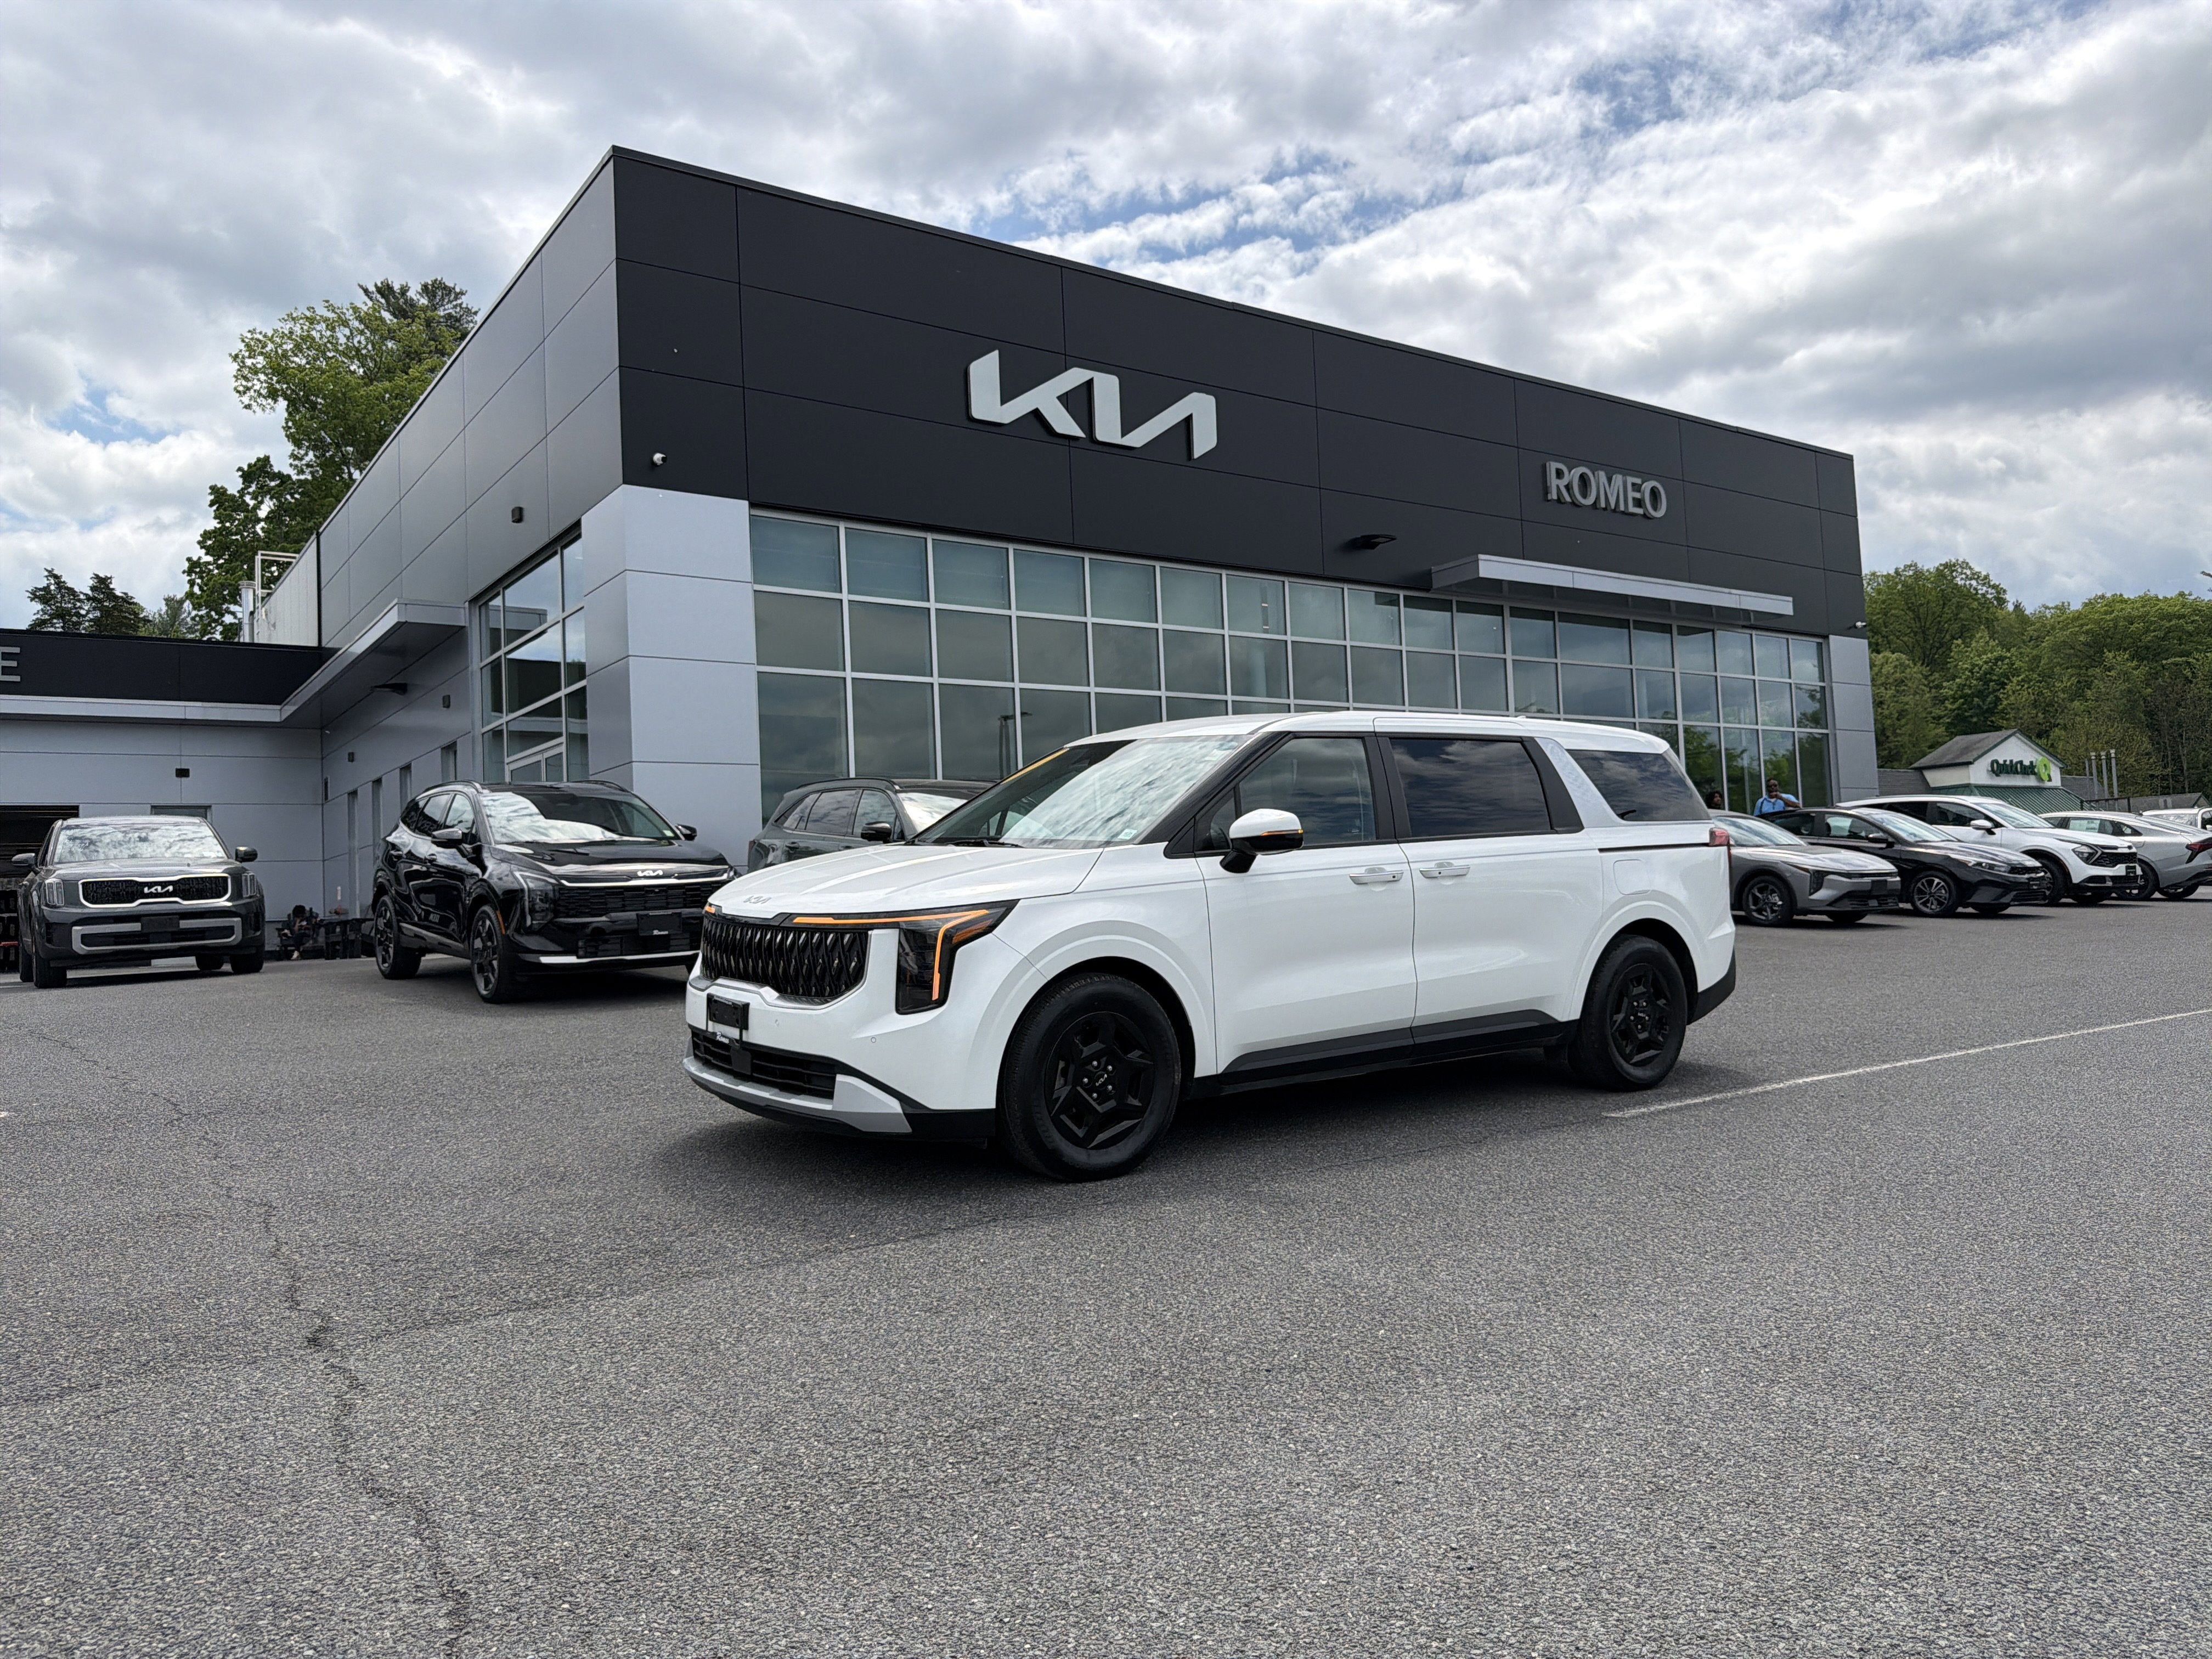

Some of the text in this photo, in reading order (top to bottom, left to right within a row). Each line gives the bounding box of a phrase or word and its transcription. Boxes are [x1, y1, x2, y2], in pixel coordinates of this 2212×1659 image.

[968, 349, 1217, 459] KIA
[1546, 461, 1667, 518] ROMEO
[144, 885, 173, 894] KIA
